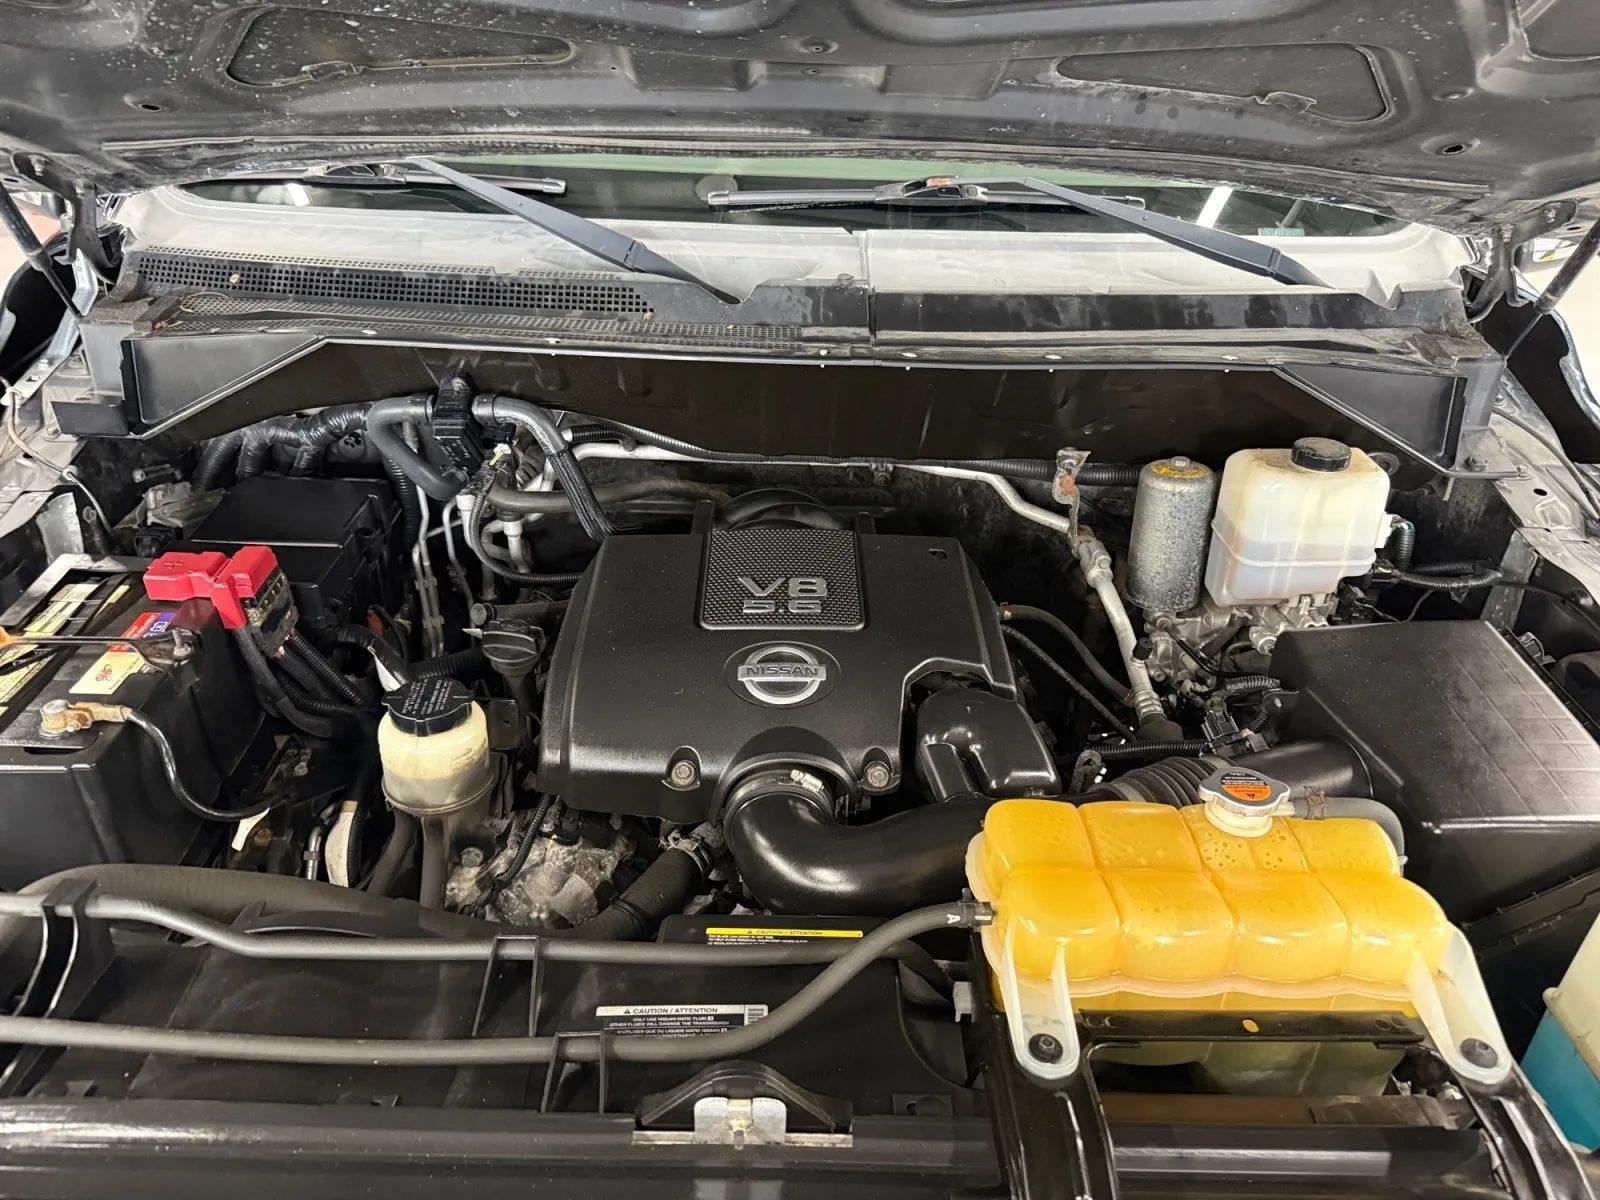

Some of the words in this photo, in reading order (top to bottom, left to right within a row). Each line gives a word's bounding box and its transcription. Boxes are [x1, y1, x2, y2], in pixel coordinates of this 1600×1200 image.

[738, 577, 828, 597] V8
[742, 599, 822, 613] 5.6
[745, 665, 818, 676] NISSAN
